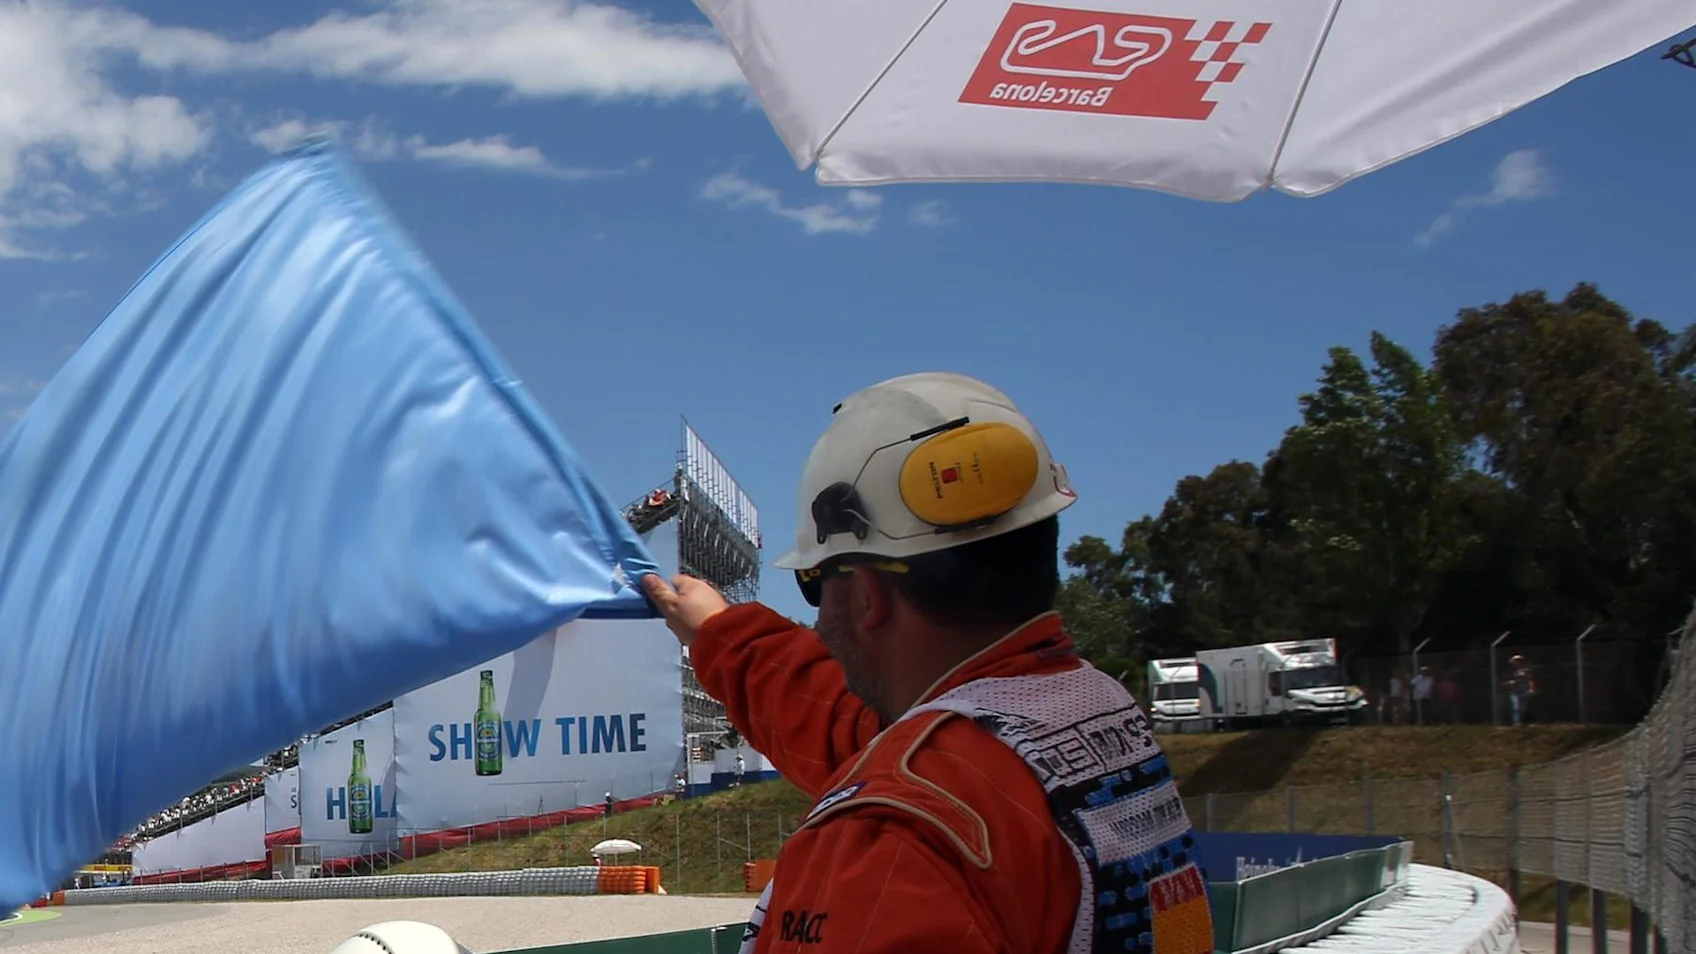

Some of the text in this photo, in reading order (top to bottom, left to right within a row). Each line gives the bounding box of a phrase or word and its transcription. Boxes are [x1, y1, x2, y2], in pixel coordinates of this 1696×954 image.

[428, 713, 646, 762] SHW TIME
[327, 785, 397, 820] HL
